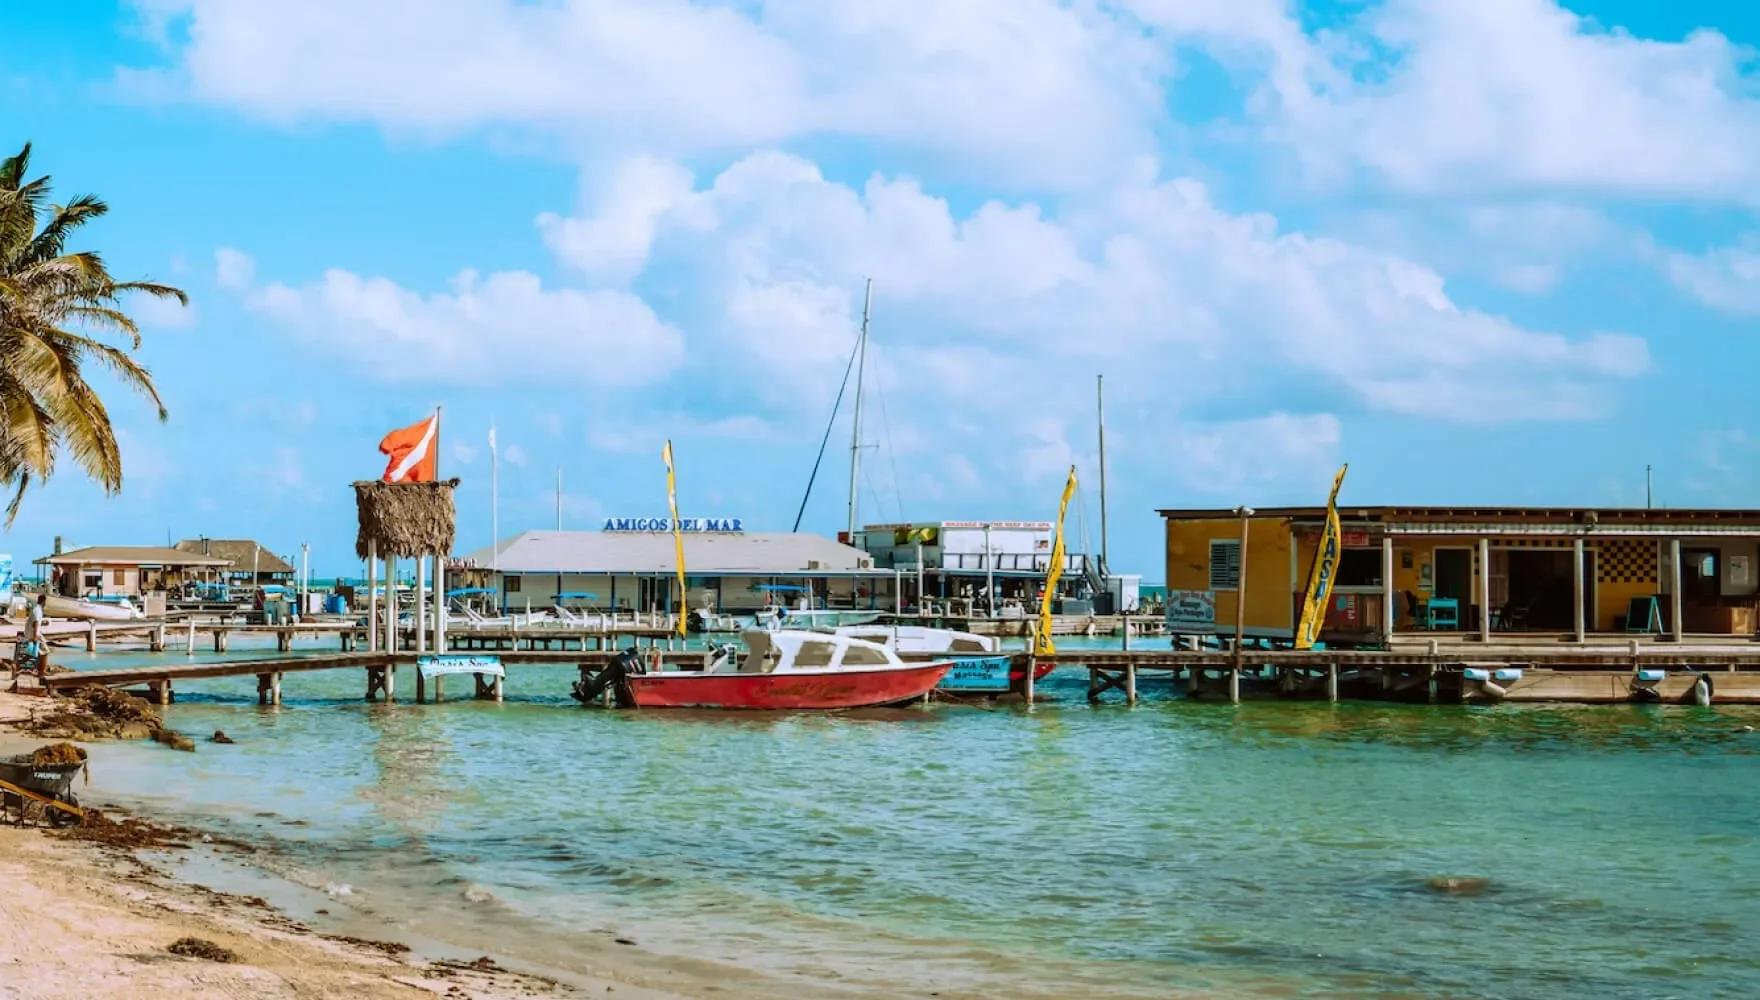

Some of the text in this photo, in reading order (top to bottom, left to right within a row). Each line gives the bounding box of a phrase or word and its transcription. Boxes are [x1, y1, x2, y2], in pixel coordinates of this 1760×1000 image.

[605, 518, 743, 531] AMIGOS DEL MAR
[980, 660, 1000, 672] Spa
